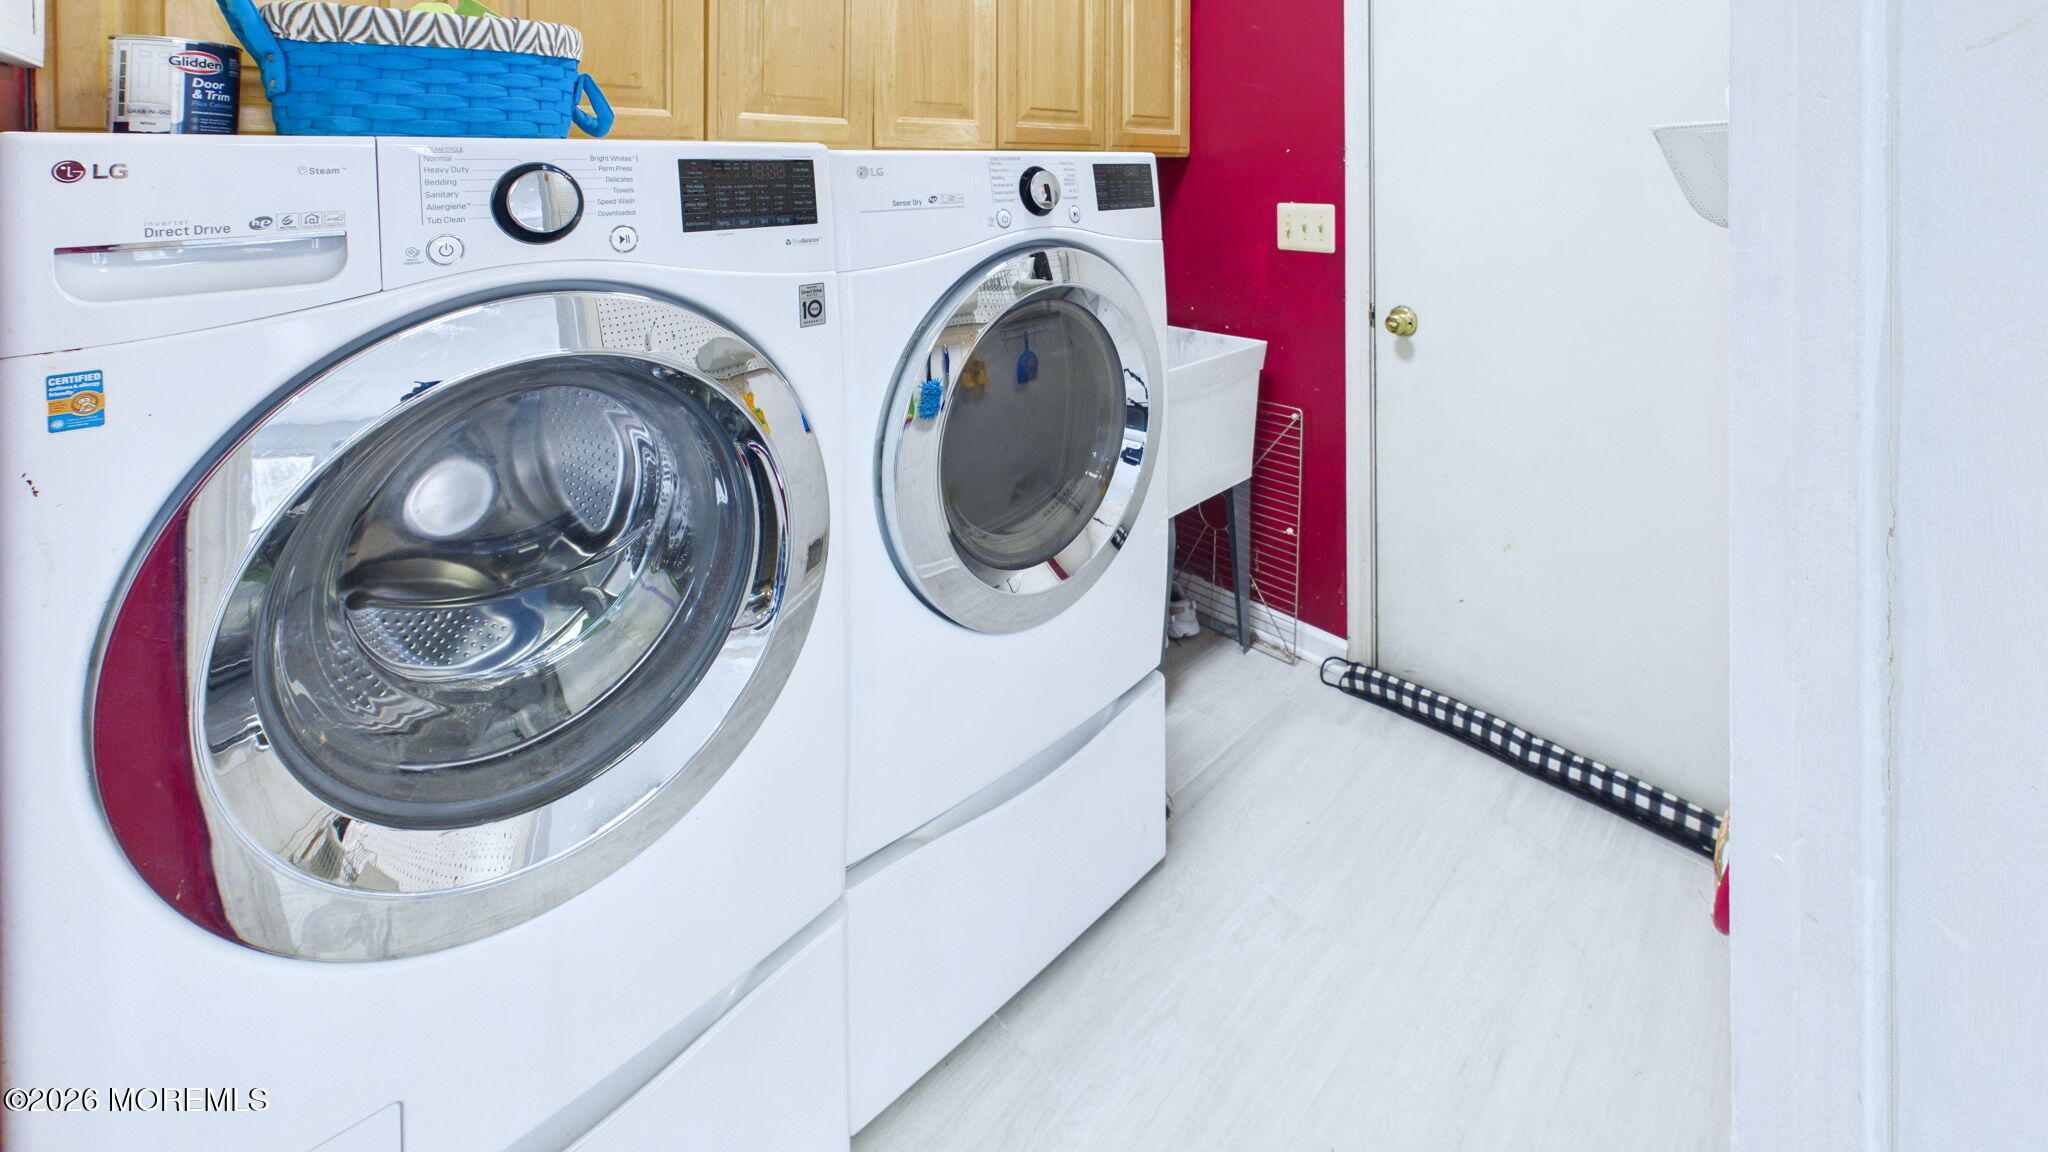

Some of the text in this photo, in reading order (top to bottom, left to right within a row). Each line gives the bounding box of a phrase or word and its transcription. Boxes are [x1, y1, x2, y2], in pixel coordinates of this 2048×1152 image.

[169, 55, 222, 70] Glidden
[192, 78, 224, 90] Door
[192, 90, 230, 102] & Trim
[93, 163, 129, 179] LG
[451, 166, 470, 175] Duty
[870, 168, 884, 177] LG
[424, 179, 457, 187] Bedding
[425, 190, 459, 199] Sanitary
[912, 199, 923, 207] Dry
[443, 216, 466, 224] Clean
[144, 224, 231, 238] Direct Drive
[802, 299, 822, 319] 10
[48, 373, 101, 386] CERTIFIED
